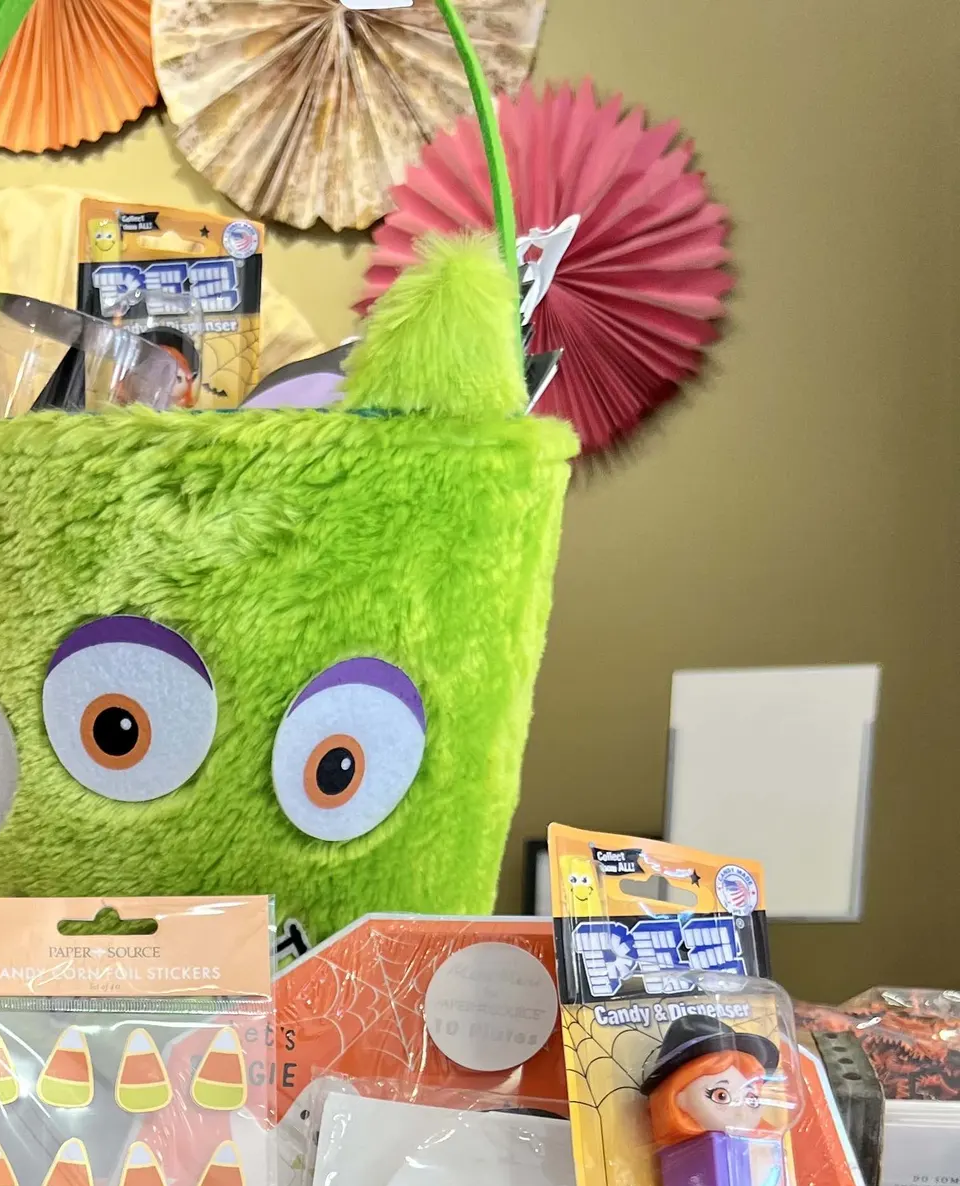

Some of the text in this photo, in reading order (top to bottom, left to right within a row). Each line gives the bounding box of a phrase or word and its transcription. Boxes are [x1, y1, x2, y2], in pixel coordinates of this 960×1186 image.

[92, 259, 241, 318] PEZ
[596, 851, 625, 862] Collect
[618, 862, 636, 872] ALL!
[49, 946, 161, 959] PAPER SOURCE
[572, 917, 747, 996] PEZ
[52, 966, 98, 981] CORN
[105, 966, 142, 980] FOIL
[146, 966, 221, 980] STICKERS
[593, 1002, 752, 1027] Candy & Dispenser
